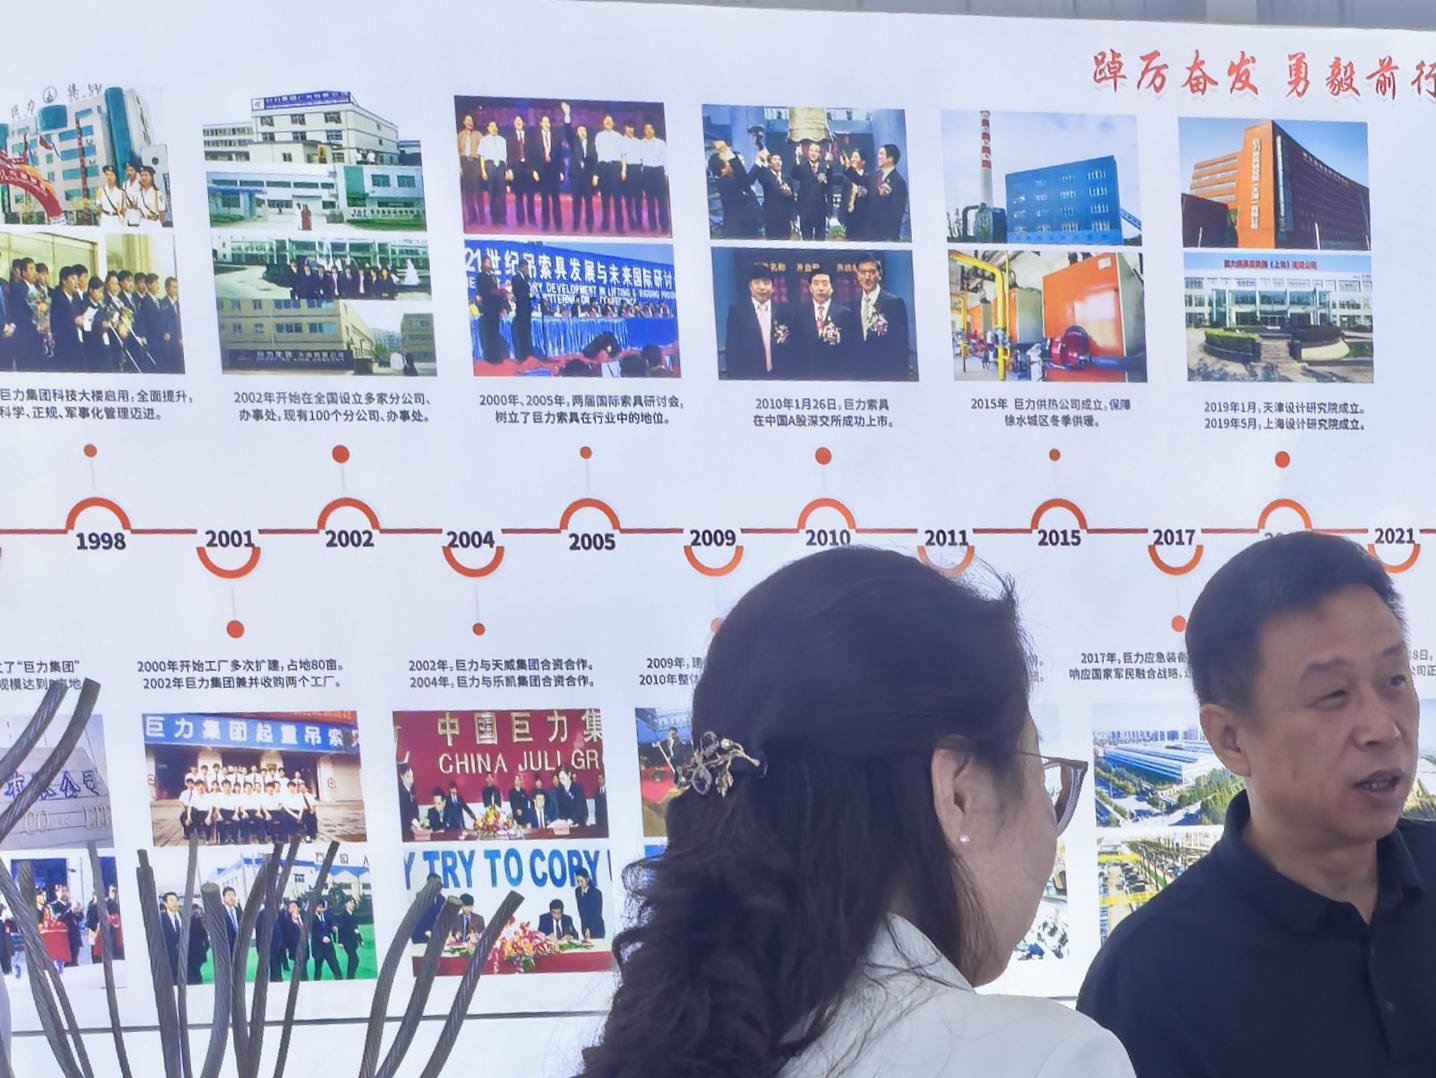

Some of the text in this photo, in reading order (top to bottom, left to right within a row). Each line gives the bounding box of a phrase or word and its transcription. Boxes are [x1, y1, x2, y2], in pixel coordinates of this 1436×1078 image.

[1093, 48, 1259, 96] 踔厉奋发
[971, 398, 1008, 411] 2015年
[76, 532, 126, 550] 1998
[205, 529, 255, 548] 2001
[325, 529, 374, 548] 2002
[446, 530, 495, 548] 2004
[569, 532, 616, 550] 2005
[690, 529, 737, 547] 2009
[805, 529, 851, 546] 2010
[924, 529, 969, 547] 2011
[1037, 529, 1082, 546] 2015
[1152, 528, 1195, 546] 2017
[1374, 527, 1415, 545] 2021
[439, 749, 600, 774] CHINA JULI GR
[4, 769, 100, 799] 有公司
[422, 850, 476, 889] TRY
[484, 848, 524, 888] TO
[529, 848, 600, 888] COPY
